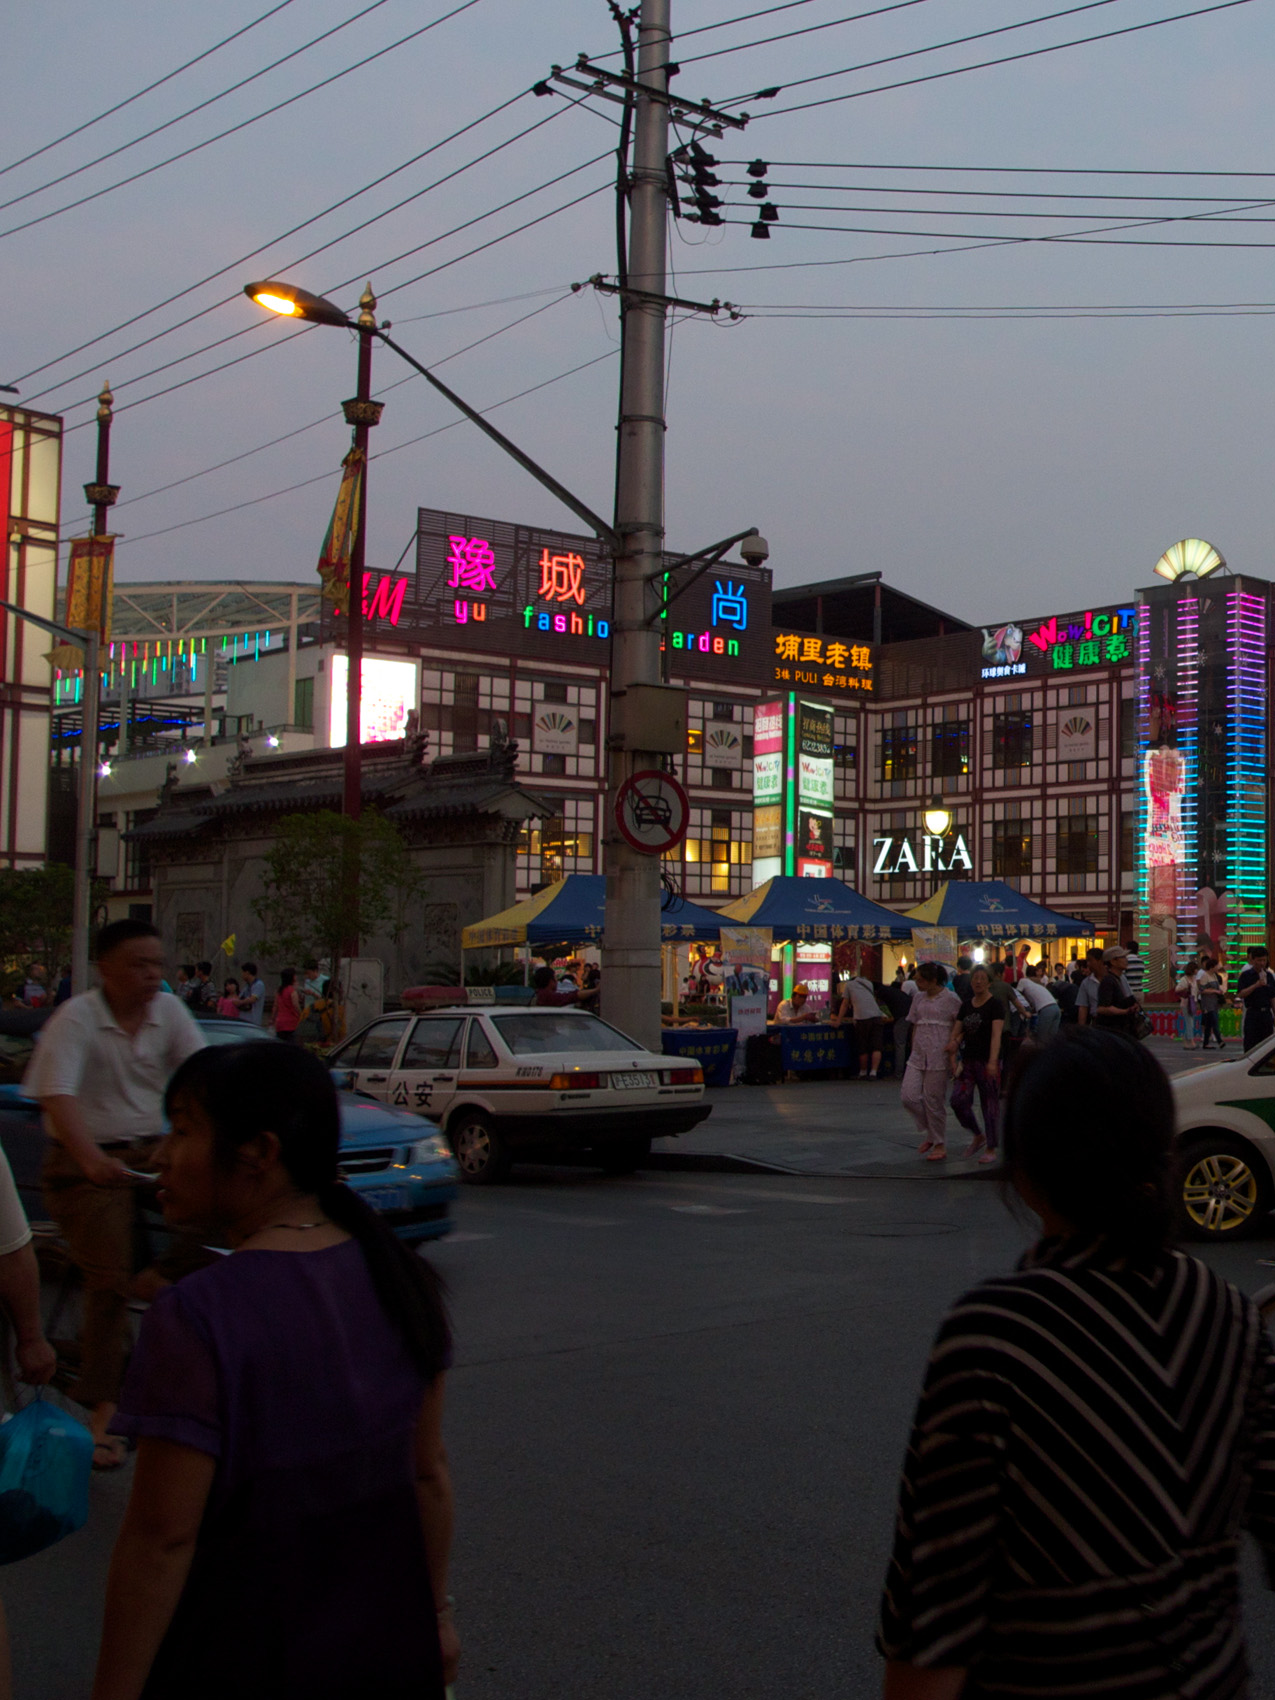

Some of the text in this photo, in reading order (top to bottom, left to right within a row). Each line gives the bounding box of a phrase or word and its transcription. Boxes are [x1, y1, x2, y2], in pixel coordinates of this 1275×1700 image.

[455, 600, 739, 656] yu fashio arden
[795, 670, 817, 684] PULI
[873, 834, 973, 875] ZARA
[796, 924, 892, 939] 中国体育彩票
[469, 987, 493, 997] POLICE
[392, 1081, 433, 1108] 公安
